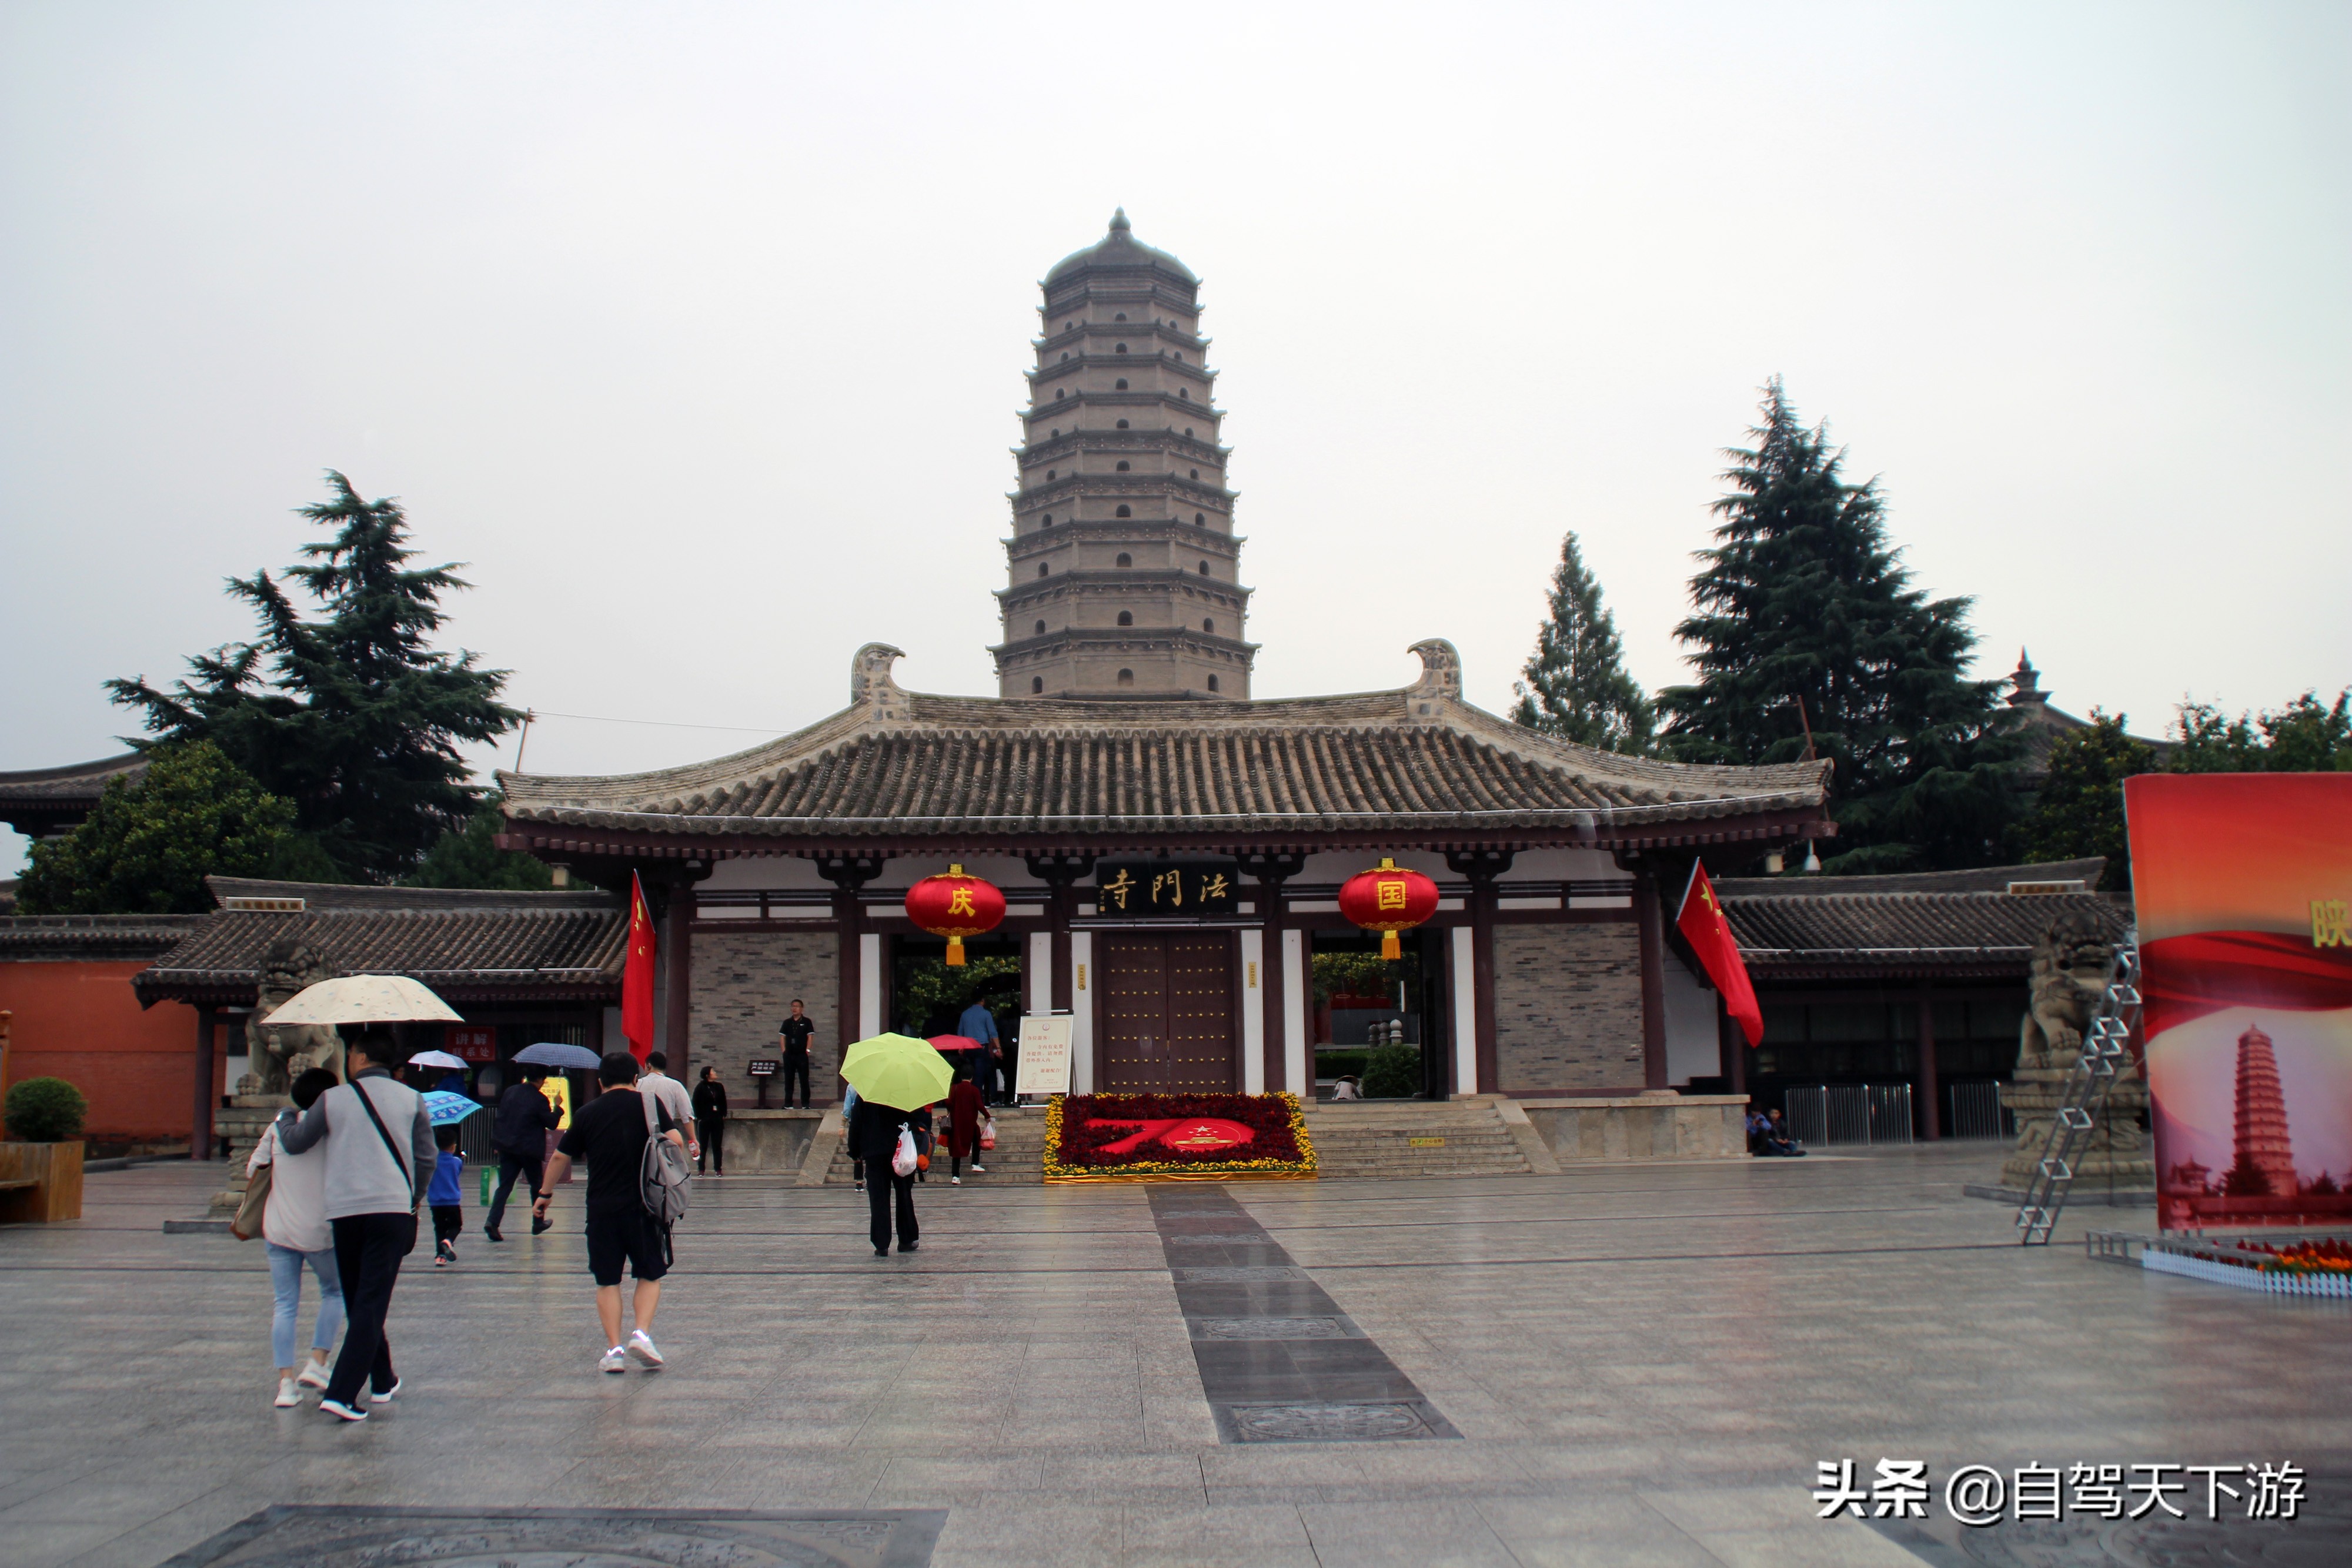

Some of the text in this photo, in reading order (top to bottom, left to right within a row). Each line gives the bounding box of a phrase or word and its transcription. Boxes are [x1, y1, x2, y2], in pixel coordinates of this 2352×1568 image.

[948, 887, 975, 917] 庆
[1104, 868, 1229, 909] 法門寺
[1377, 881, 1406, 910] 国
